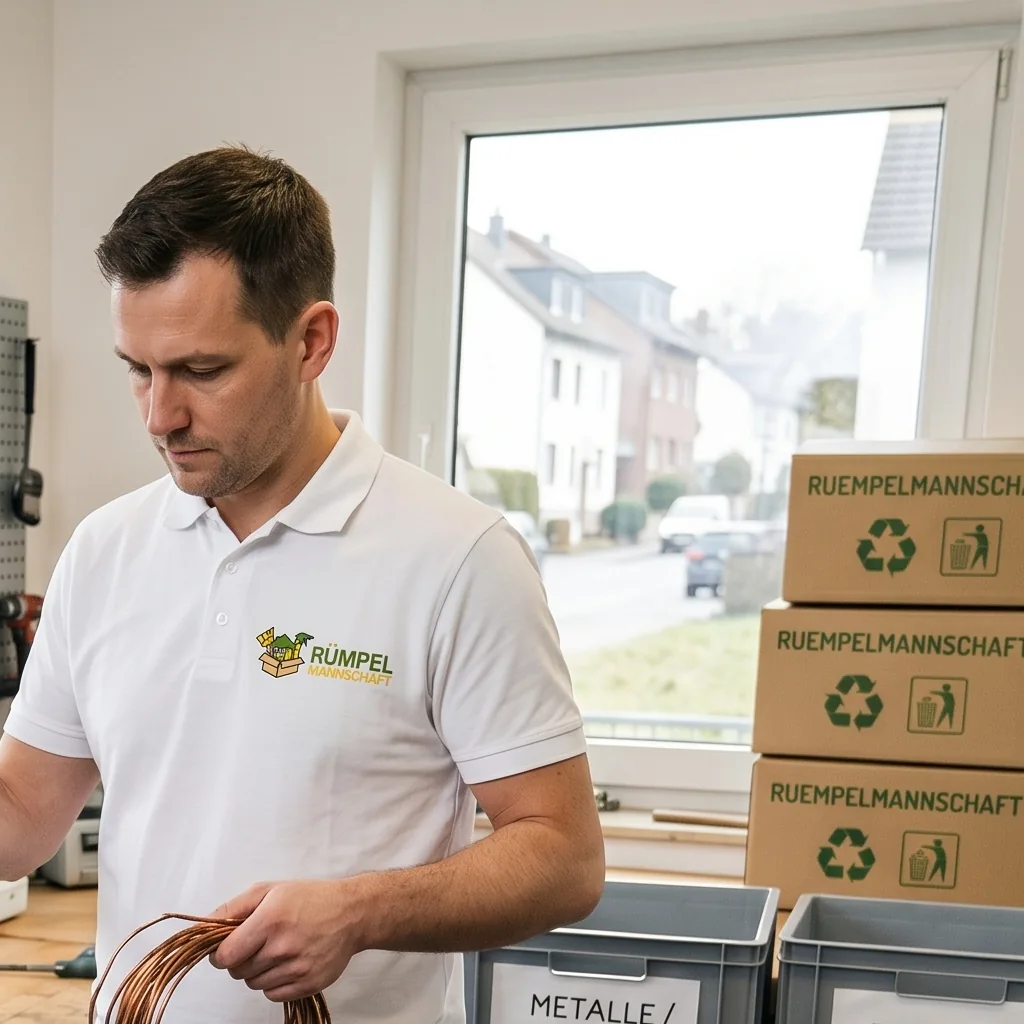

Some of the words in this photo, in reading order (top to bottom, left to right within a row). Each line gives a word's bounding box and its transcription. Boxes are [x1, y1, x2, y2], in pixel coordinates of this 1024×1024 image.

[808, 474, 1024, 497] RUEMPELMANNSCH
[310, 642, 393, 675] RÜMPEL
[777, 630, 1024, 659] RUEMPELMANNSCHAFT
[307, 665, 392, 686] MANNSCHAFT
[770, 782, 1024, 817] RUEMPELMANNSCHAFT
